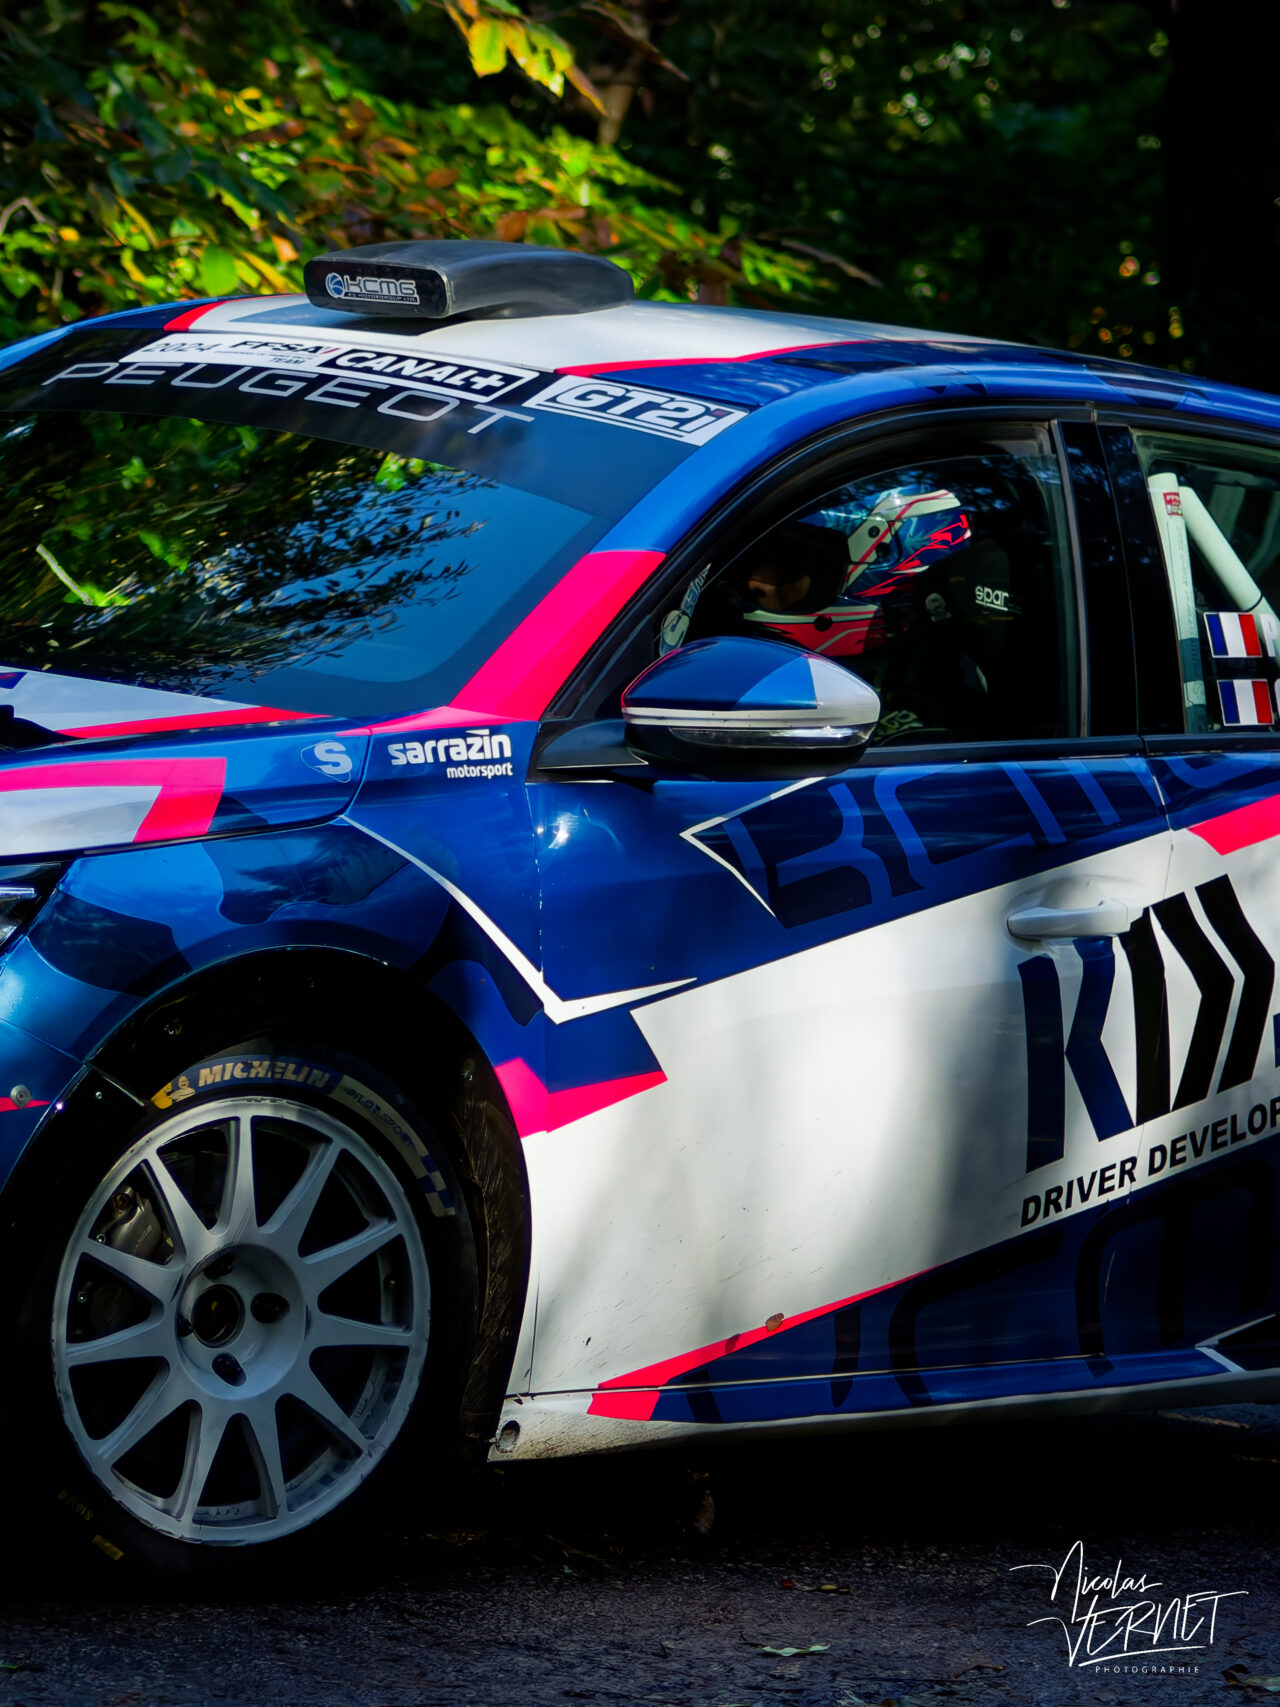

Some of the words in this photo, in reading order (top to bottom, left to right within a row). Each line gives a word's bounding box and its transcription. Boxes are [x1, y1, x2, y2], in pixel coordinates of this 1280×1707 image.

[142, 342, 222, 353] 2024
[230, 340, 328, 354] FFSA
[335, 352, 506, 390] CANAL+
[269, 357, 307, 366] TEAM
[41, 362, 536, 434] PEUGEOT
[974, 584, 1011, 609] spar
[387, 729, 512, 766] sarrazin
[446, 761, 513, 780] motorsport
[198, 1060, 330, 1089] MICHELIN
[1020, 1156, 1137, 1228] DRIVER
